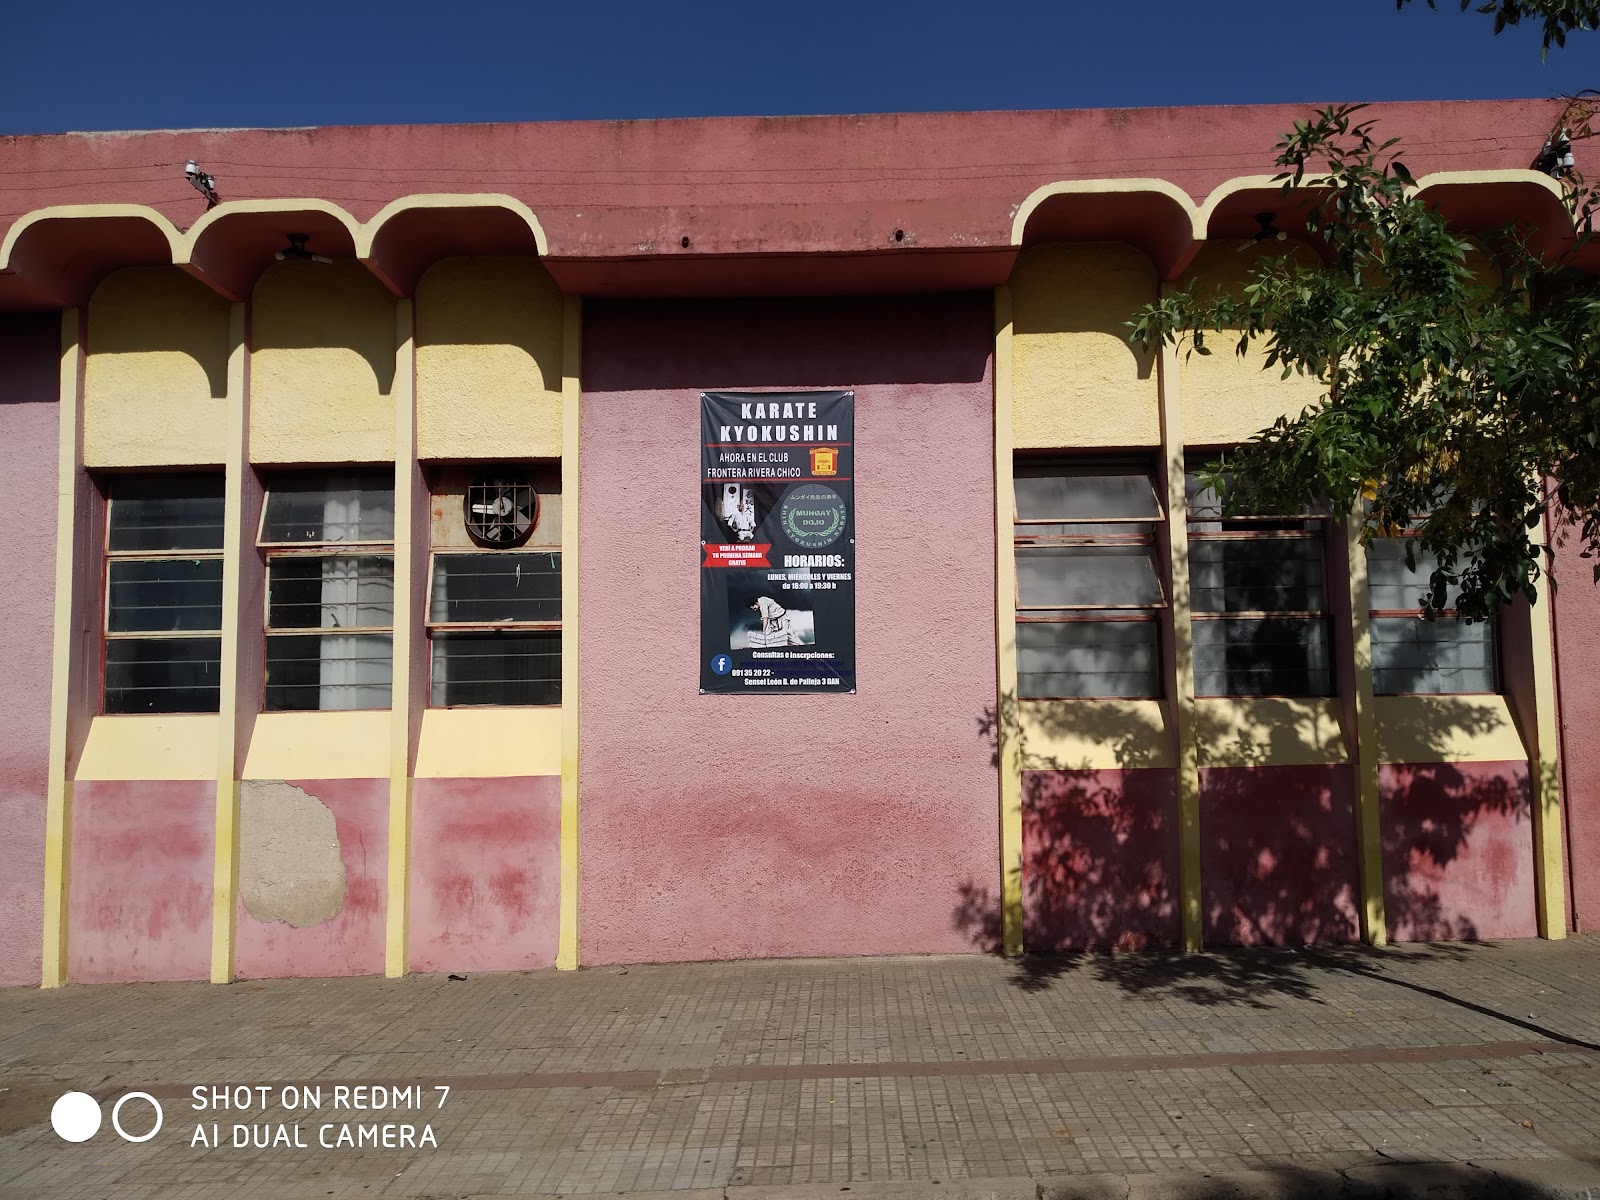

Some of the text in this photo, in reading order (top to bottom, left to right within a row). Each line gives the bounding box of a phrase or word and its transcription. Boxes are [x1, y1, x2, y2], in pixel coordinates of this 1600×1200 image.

[741, 403, 817, 419] KARATE
[720, 425, 838, 442] KYOKUSHIN
[719, 453, 789, 463] AHORA EN EL CLUB
[707, 468, 747, 478] FRONTERA
[748, 468, 775, 477] RIVERA
[777, 467, 801, 477] CHICO
[784, 554, 845, 567] HORARIOS:
[799, 678, 821, 686] Palleja
